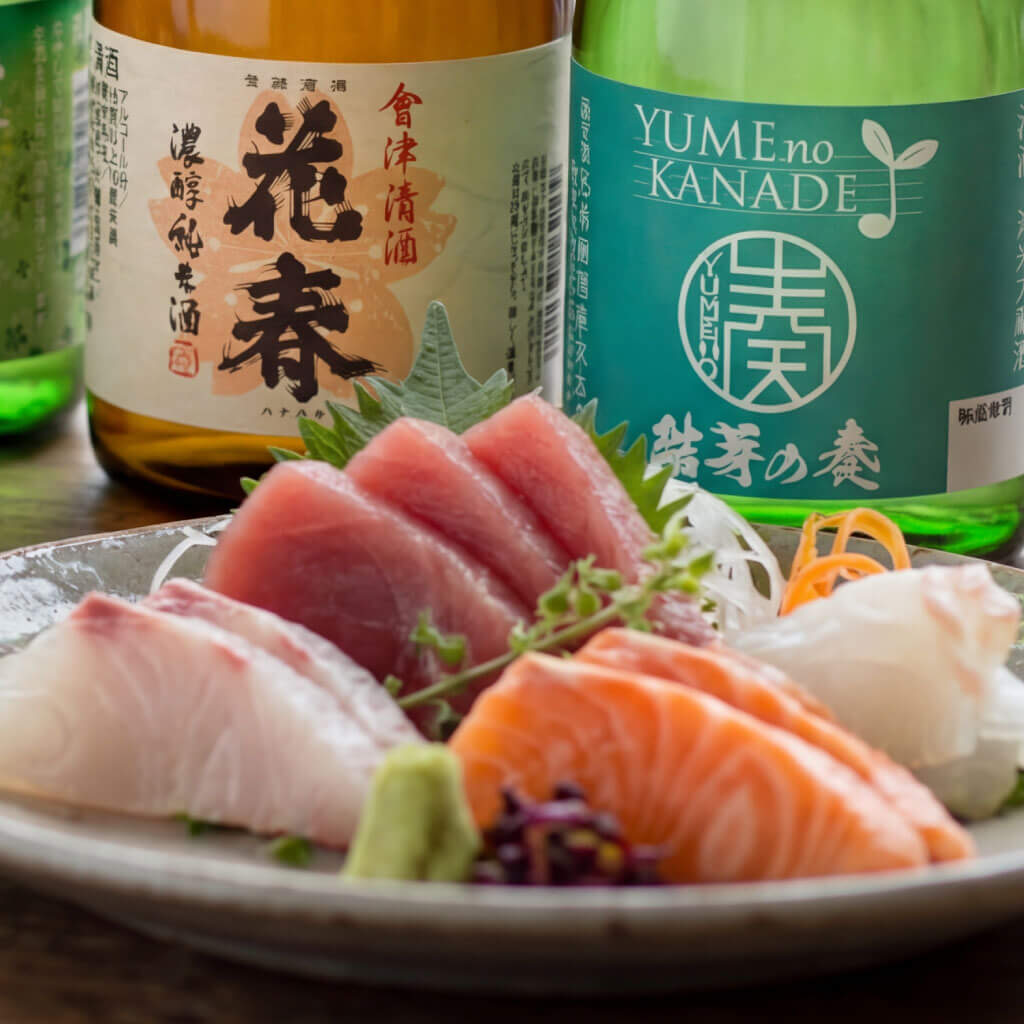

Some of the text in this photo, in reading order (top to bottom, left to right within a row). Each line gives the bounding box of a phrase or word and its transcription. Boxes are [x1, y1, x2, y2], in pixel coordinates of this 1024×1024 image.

[379, 82, 423, 266] 會津清酒
[634, 104, 835, 165] YUME no
[648, 158, 858, 213] KANADE
[218, 97, 389, 403] 花春
